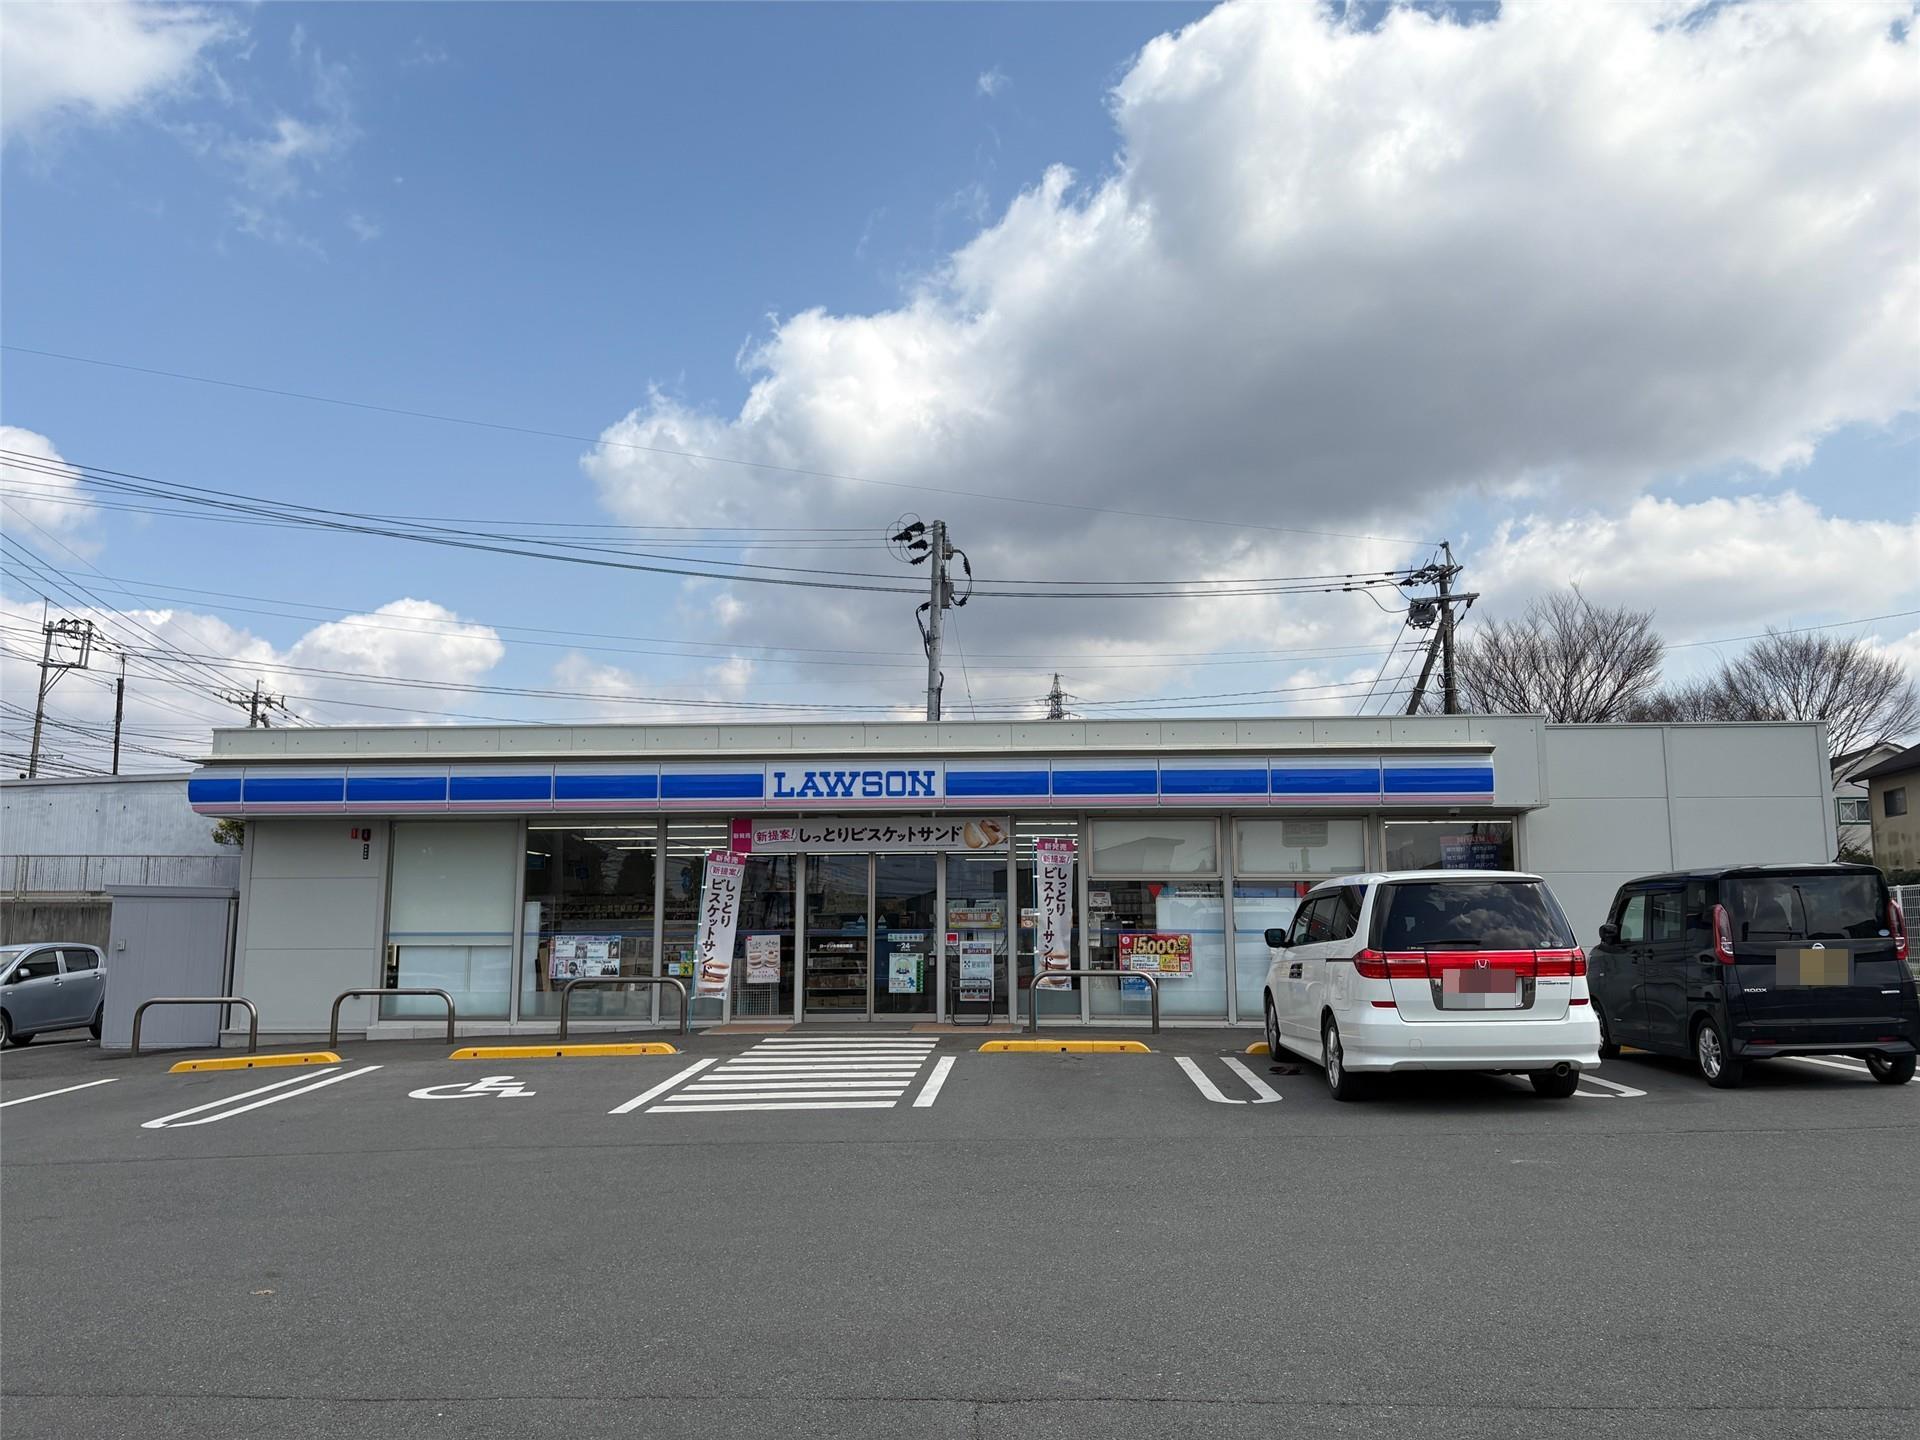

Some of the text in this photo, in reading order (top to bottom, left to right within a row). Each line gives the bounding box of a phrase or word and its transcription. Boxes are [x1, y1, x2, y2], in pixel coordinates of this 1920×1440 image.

[774, 771, 936, 798] LAWSON
[799, 825, 963, 843] しっとりビスケットサンド
[720, 880, 736, 928] しっとり
[1056, 867, 1068, 917] しっとり
[701, 878, 726, 979] ビスケットサンド
[1043, 867, 1058, 971] ビスケットサンド
